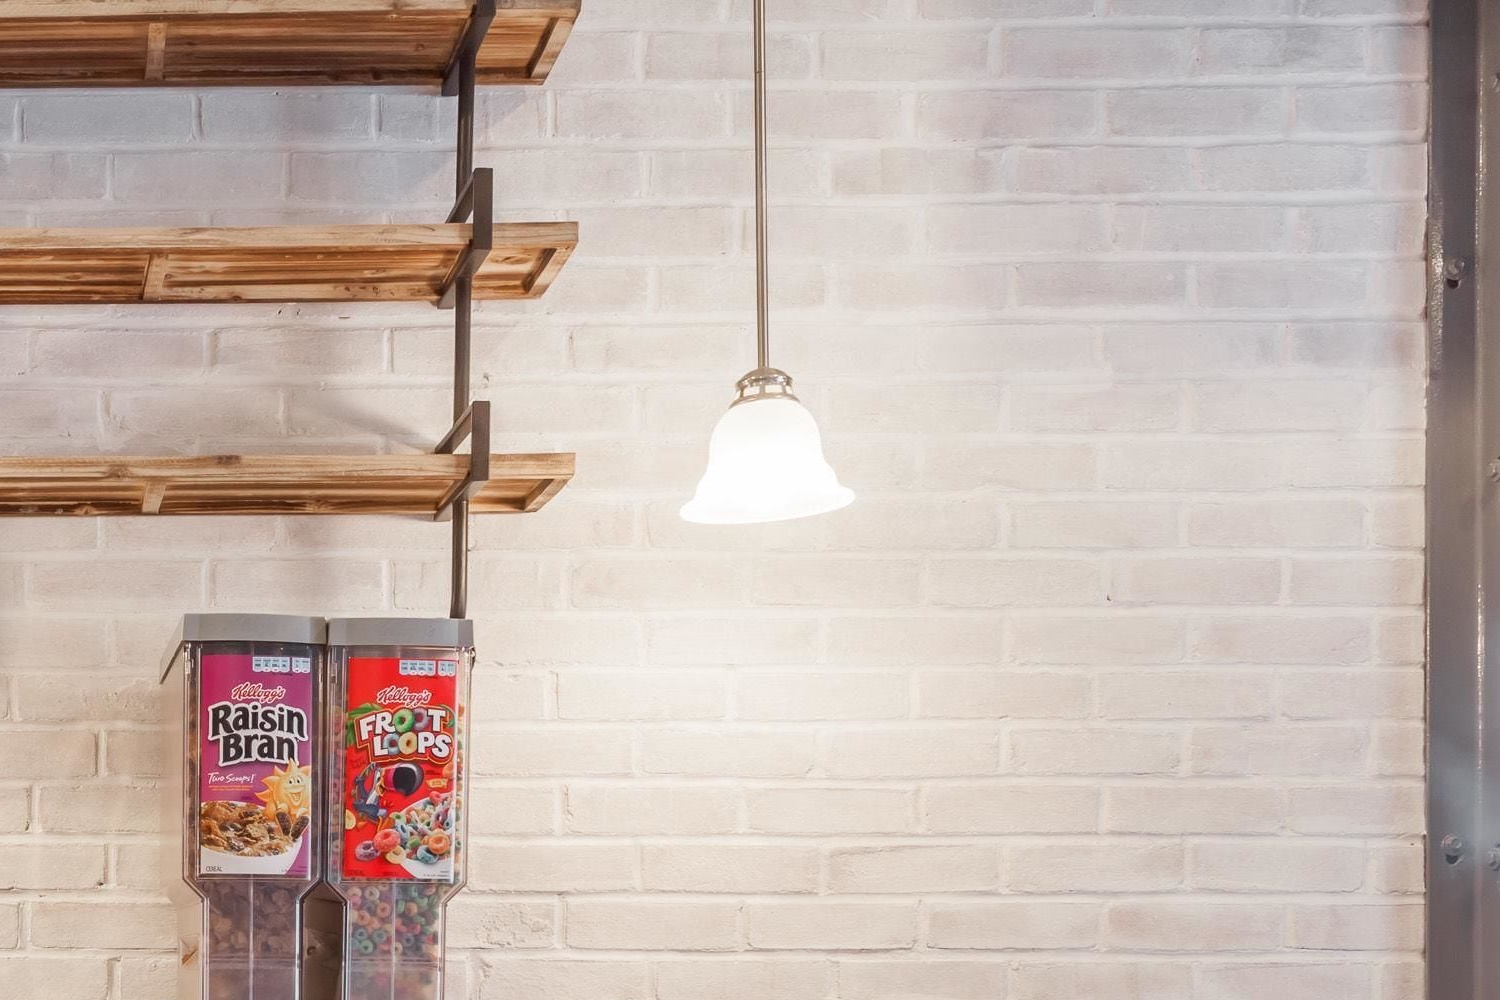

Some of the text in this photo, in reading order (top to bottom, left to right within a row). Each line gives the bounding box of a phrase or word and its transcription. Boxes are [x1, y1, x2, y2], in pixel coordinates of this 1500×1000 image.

[232, 682, 286, 703] Kellogg's
[377, 685, 432, 707] Kellogg's
[210, 703, 307, 739] Raisin
[359, 708, 446, 741] FROOT
[221, 733, 296, 764] Bran
[373, 731, 452, 758] LOOPS
[208, 772, 224, 784] Two
